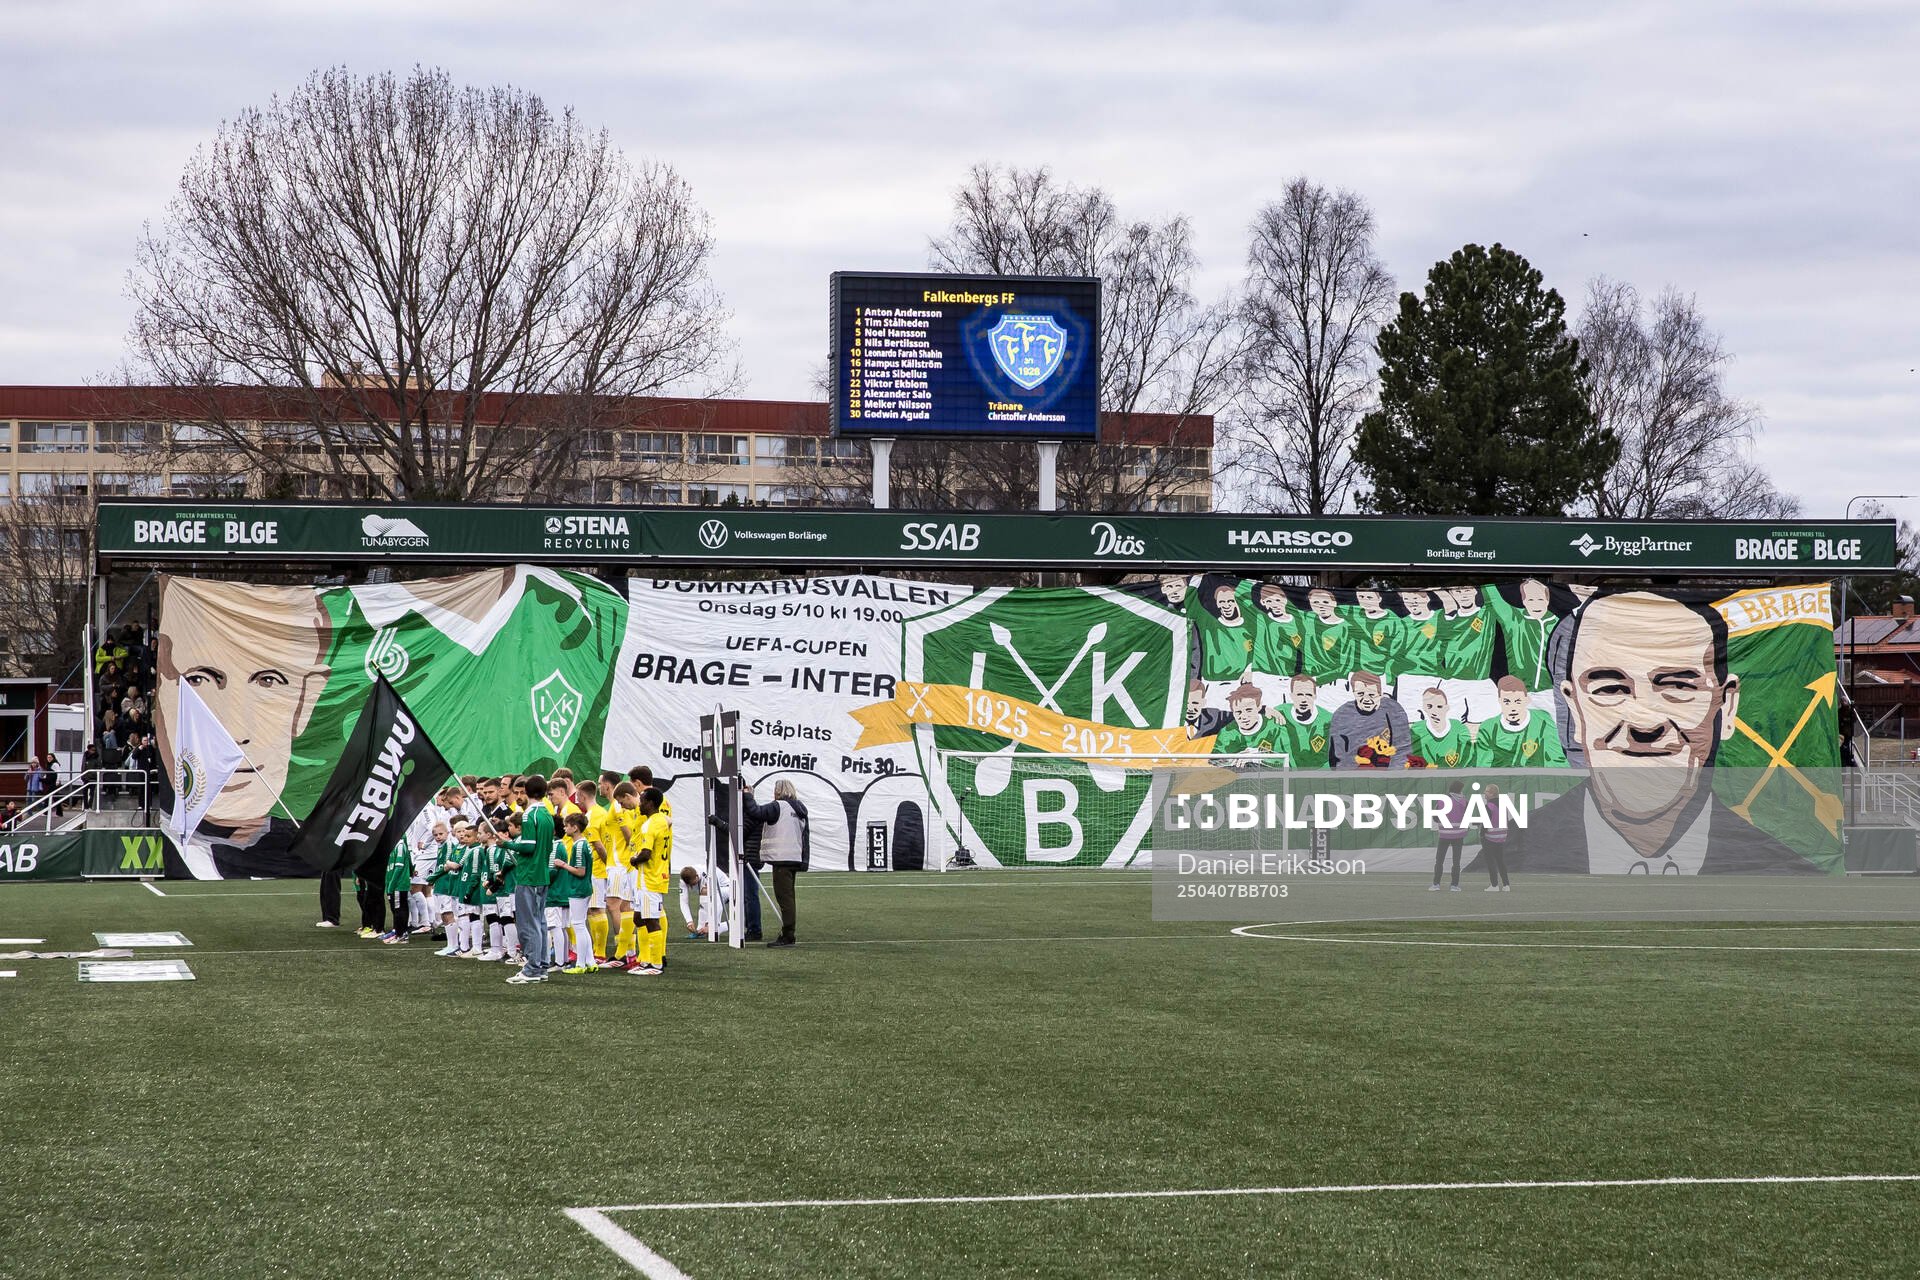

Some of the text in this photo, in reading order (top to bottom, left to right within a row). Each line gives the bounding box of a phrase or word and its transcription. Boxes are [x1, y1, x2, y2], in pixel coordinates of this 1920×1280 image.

[923, 290, 1015, 307] Falkenbergs FF
[855, 307, 942, 318] 1 Anton Andersson
[855, 317, 929, 328] 4 Tim Stålheden
[855, 328, 927, 338] 5 Noel Hansson
[855, 338, 930, 348] 8 Nils Bertilsson
[850, 348, 943, 359] 10 Leonardo Farah Shahin
[850, 359, 943, 370] 16 Hampus Källström
[850, 369, 928, 379] 17 Lucas Sibelius
[850, 379, 928, 389] 22 Viktor Ekblom
[850, 389, 932, 399] 23 Alexander Salo
[850, 399, 932, 409] 28 Melker Nilsson
[988, 402, 1023, 411] Tränare
[850, 409, 930, 421] 30 Godwin Aguda
[988, 411, 1065, 422] Christoffer Andersson
[134, 520, 278, 544] BRAGE BLGE
[564, 516, 630, 535] STENA
[361, 537, 429, 547] TUNABYGGEN
[734, 530, 828, 542] Volkswagen Borlänge
[900, 523, 981, 551] SSAB
[1091, 521, 1146, 556] Diös
[1228, 530, 1353, 547] HARSCO
[544, 538, 630, 549] RECYCLING
[1604, 536, 1692, 556] ByggPartner
[1735, 538, 1861, 560] BRAGE BLGE
[1244, 547, 1337, 555] ENVIRONMENTAL
[1426, 549, 1496, 560] Borlänge Energi
[698, 599, 903, 623] Onsdag 5/10 kl 19.00
[1738, 589, 1830, 623] BRAGE
[726, 635, 867, 657] UEFA-CUPEN
[632, 653, 752, 686] BRAGE
[791, 667, 896, 699] INTER
[750, 719, 833, 741] Ståplats
[963, 691, 1029, 738] 1925
[1061, 722, 1132, 762] 2025
[662, 742, 701, 762] Ungd
[741, 748, 817, 771] Pensionär
[841, 755, 872, 774] Pris
[1023, 778, 1084, 862] B
[873, 827, 884, 867] SELECT
[1317, 828, 1327, 864] ELECT
